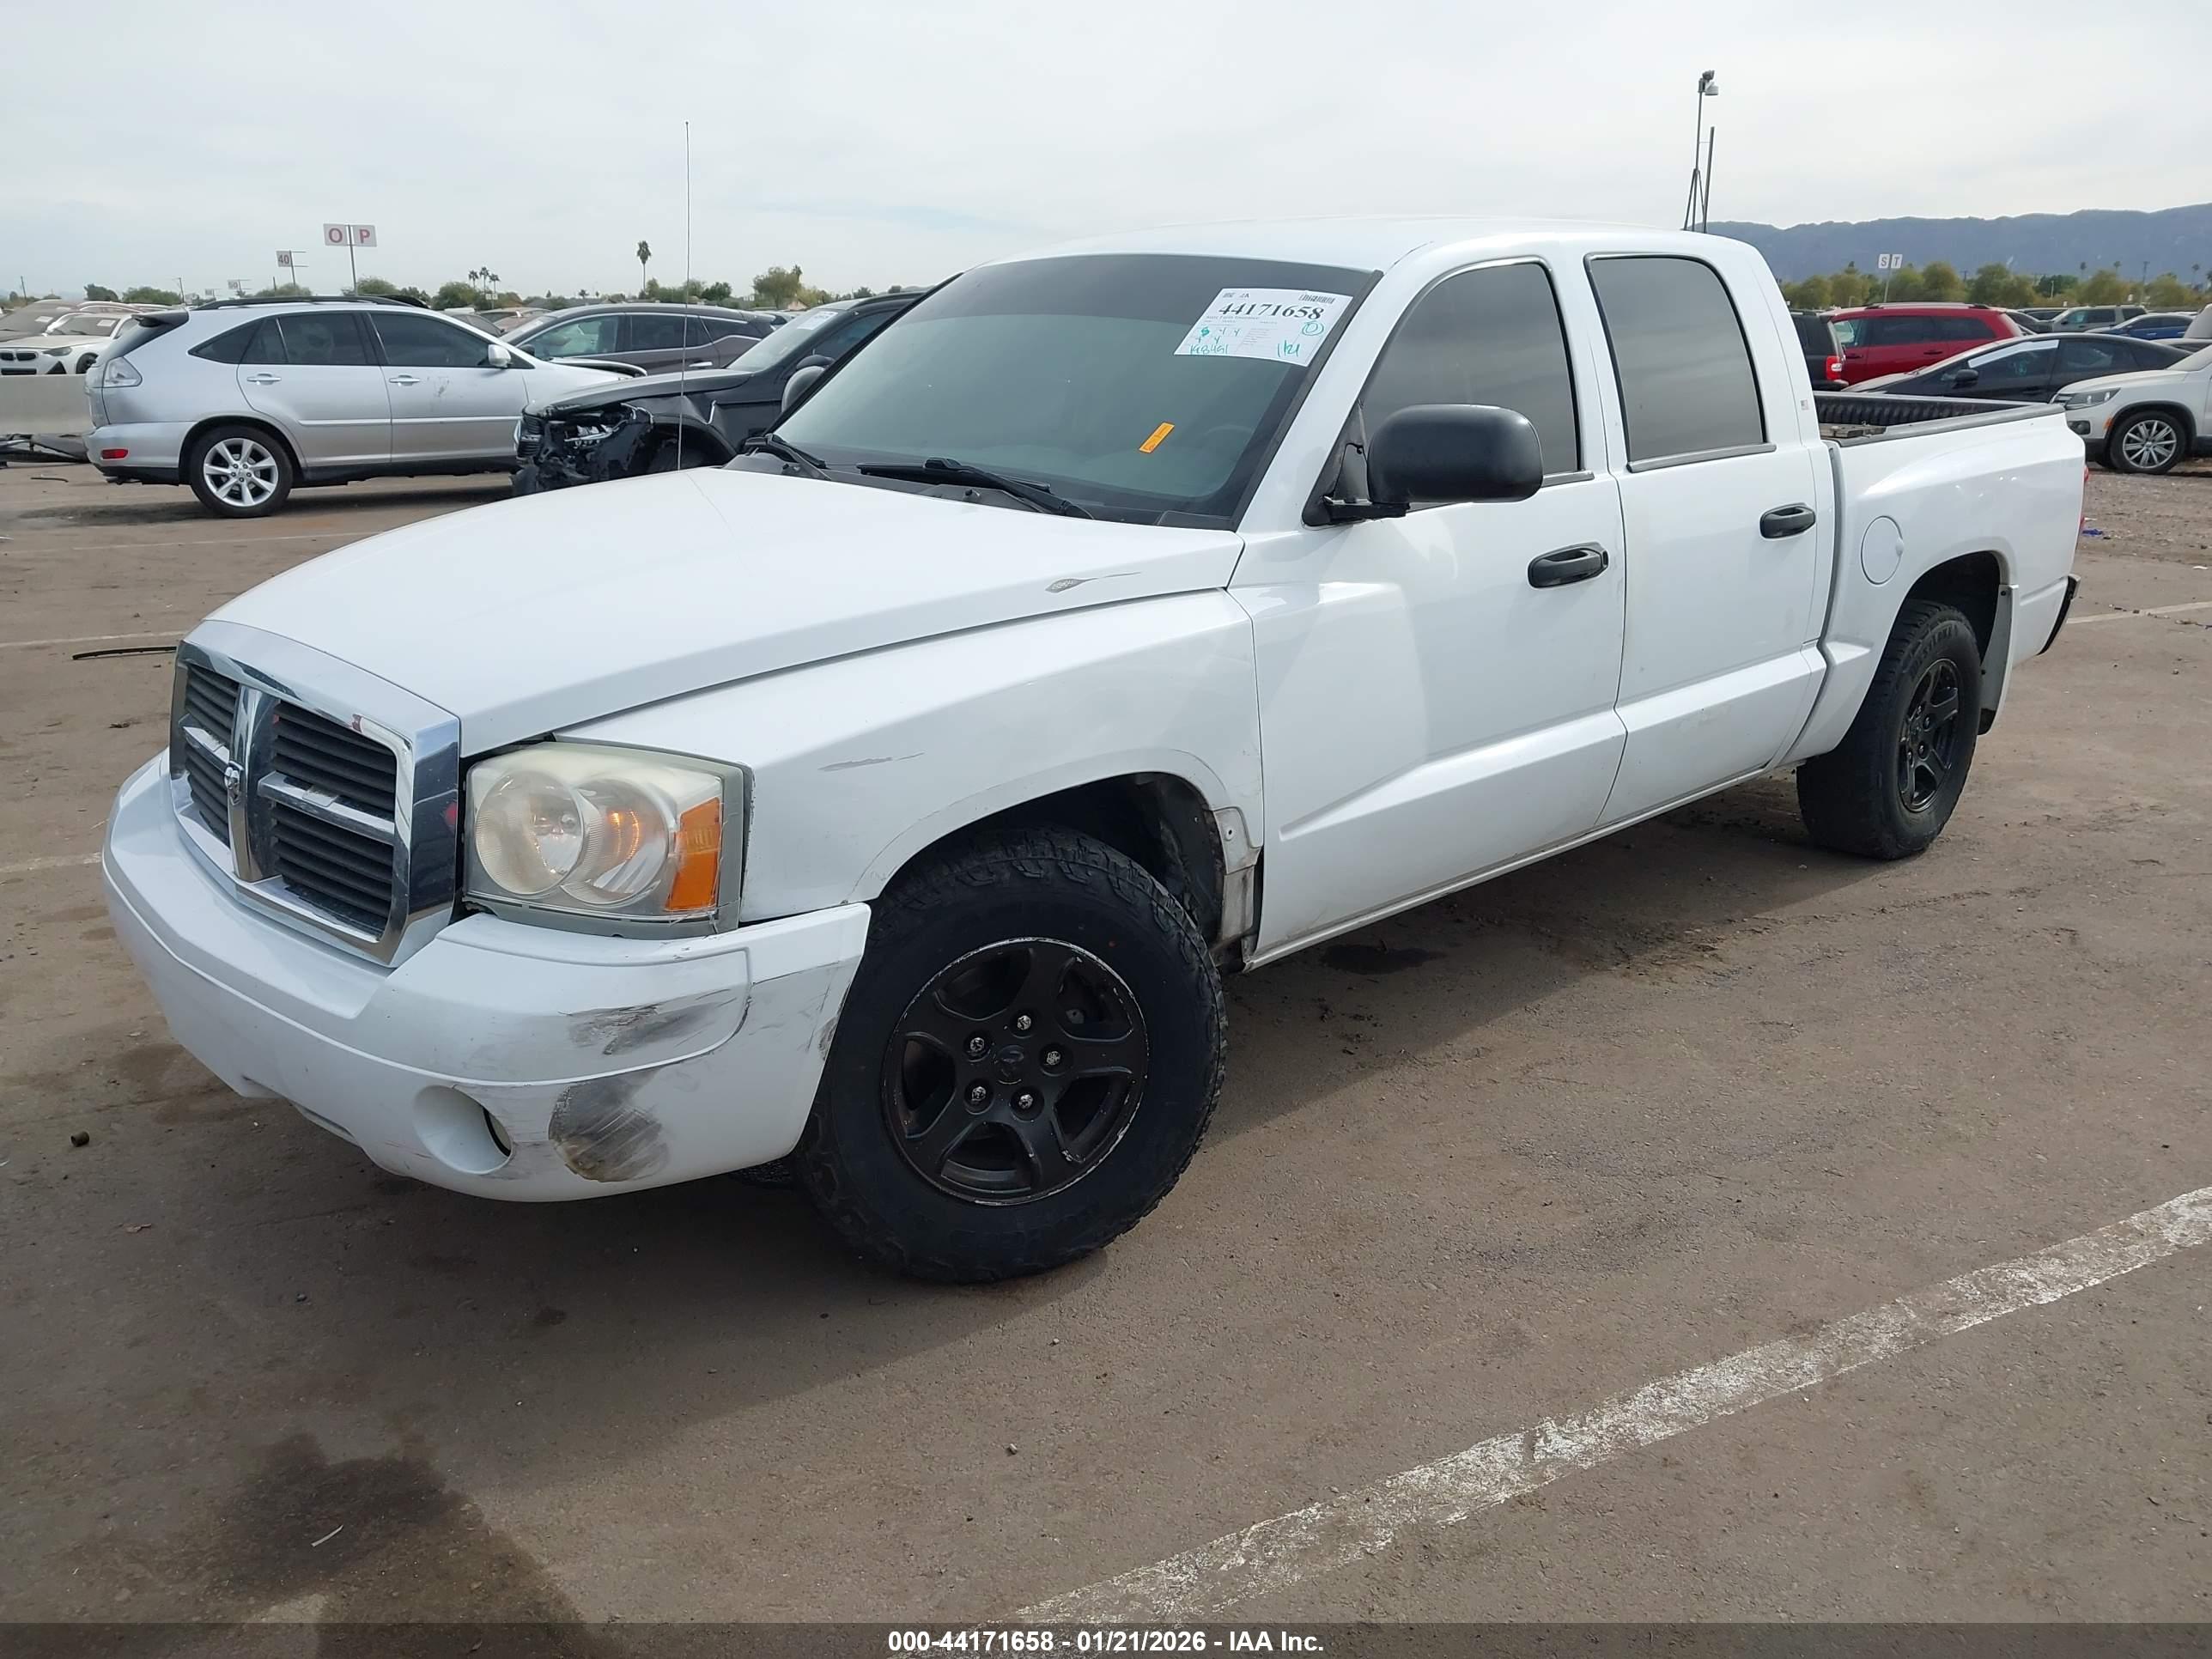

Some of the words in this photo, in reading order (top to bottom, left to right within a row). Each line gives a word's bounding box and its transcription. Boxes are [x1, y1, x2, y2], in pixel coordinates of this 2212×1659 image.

[328, 228, 343, 243] O
[359, 228, 371, 244] P
[277, 254, 290, 264] 40
[1881, 257, 1887, 266] S
[1893, 256, 1901, 266] T
[1218, 302, 1325, 320] 44171658
